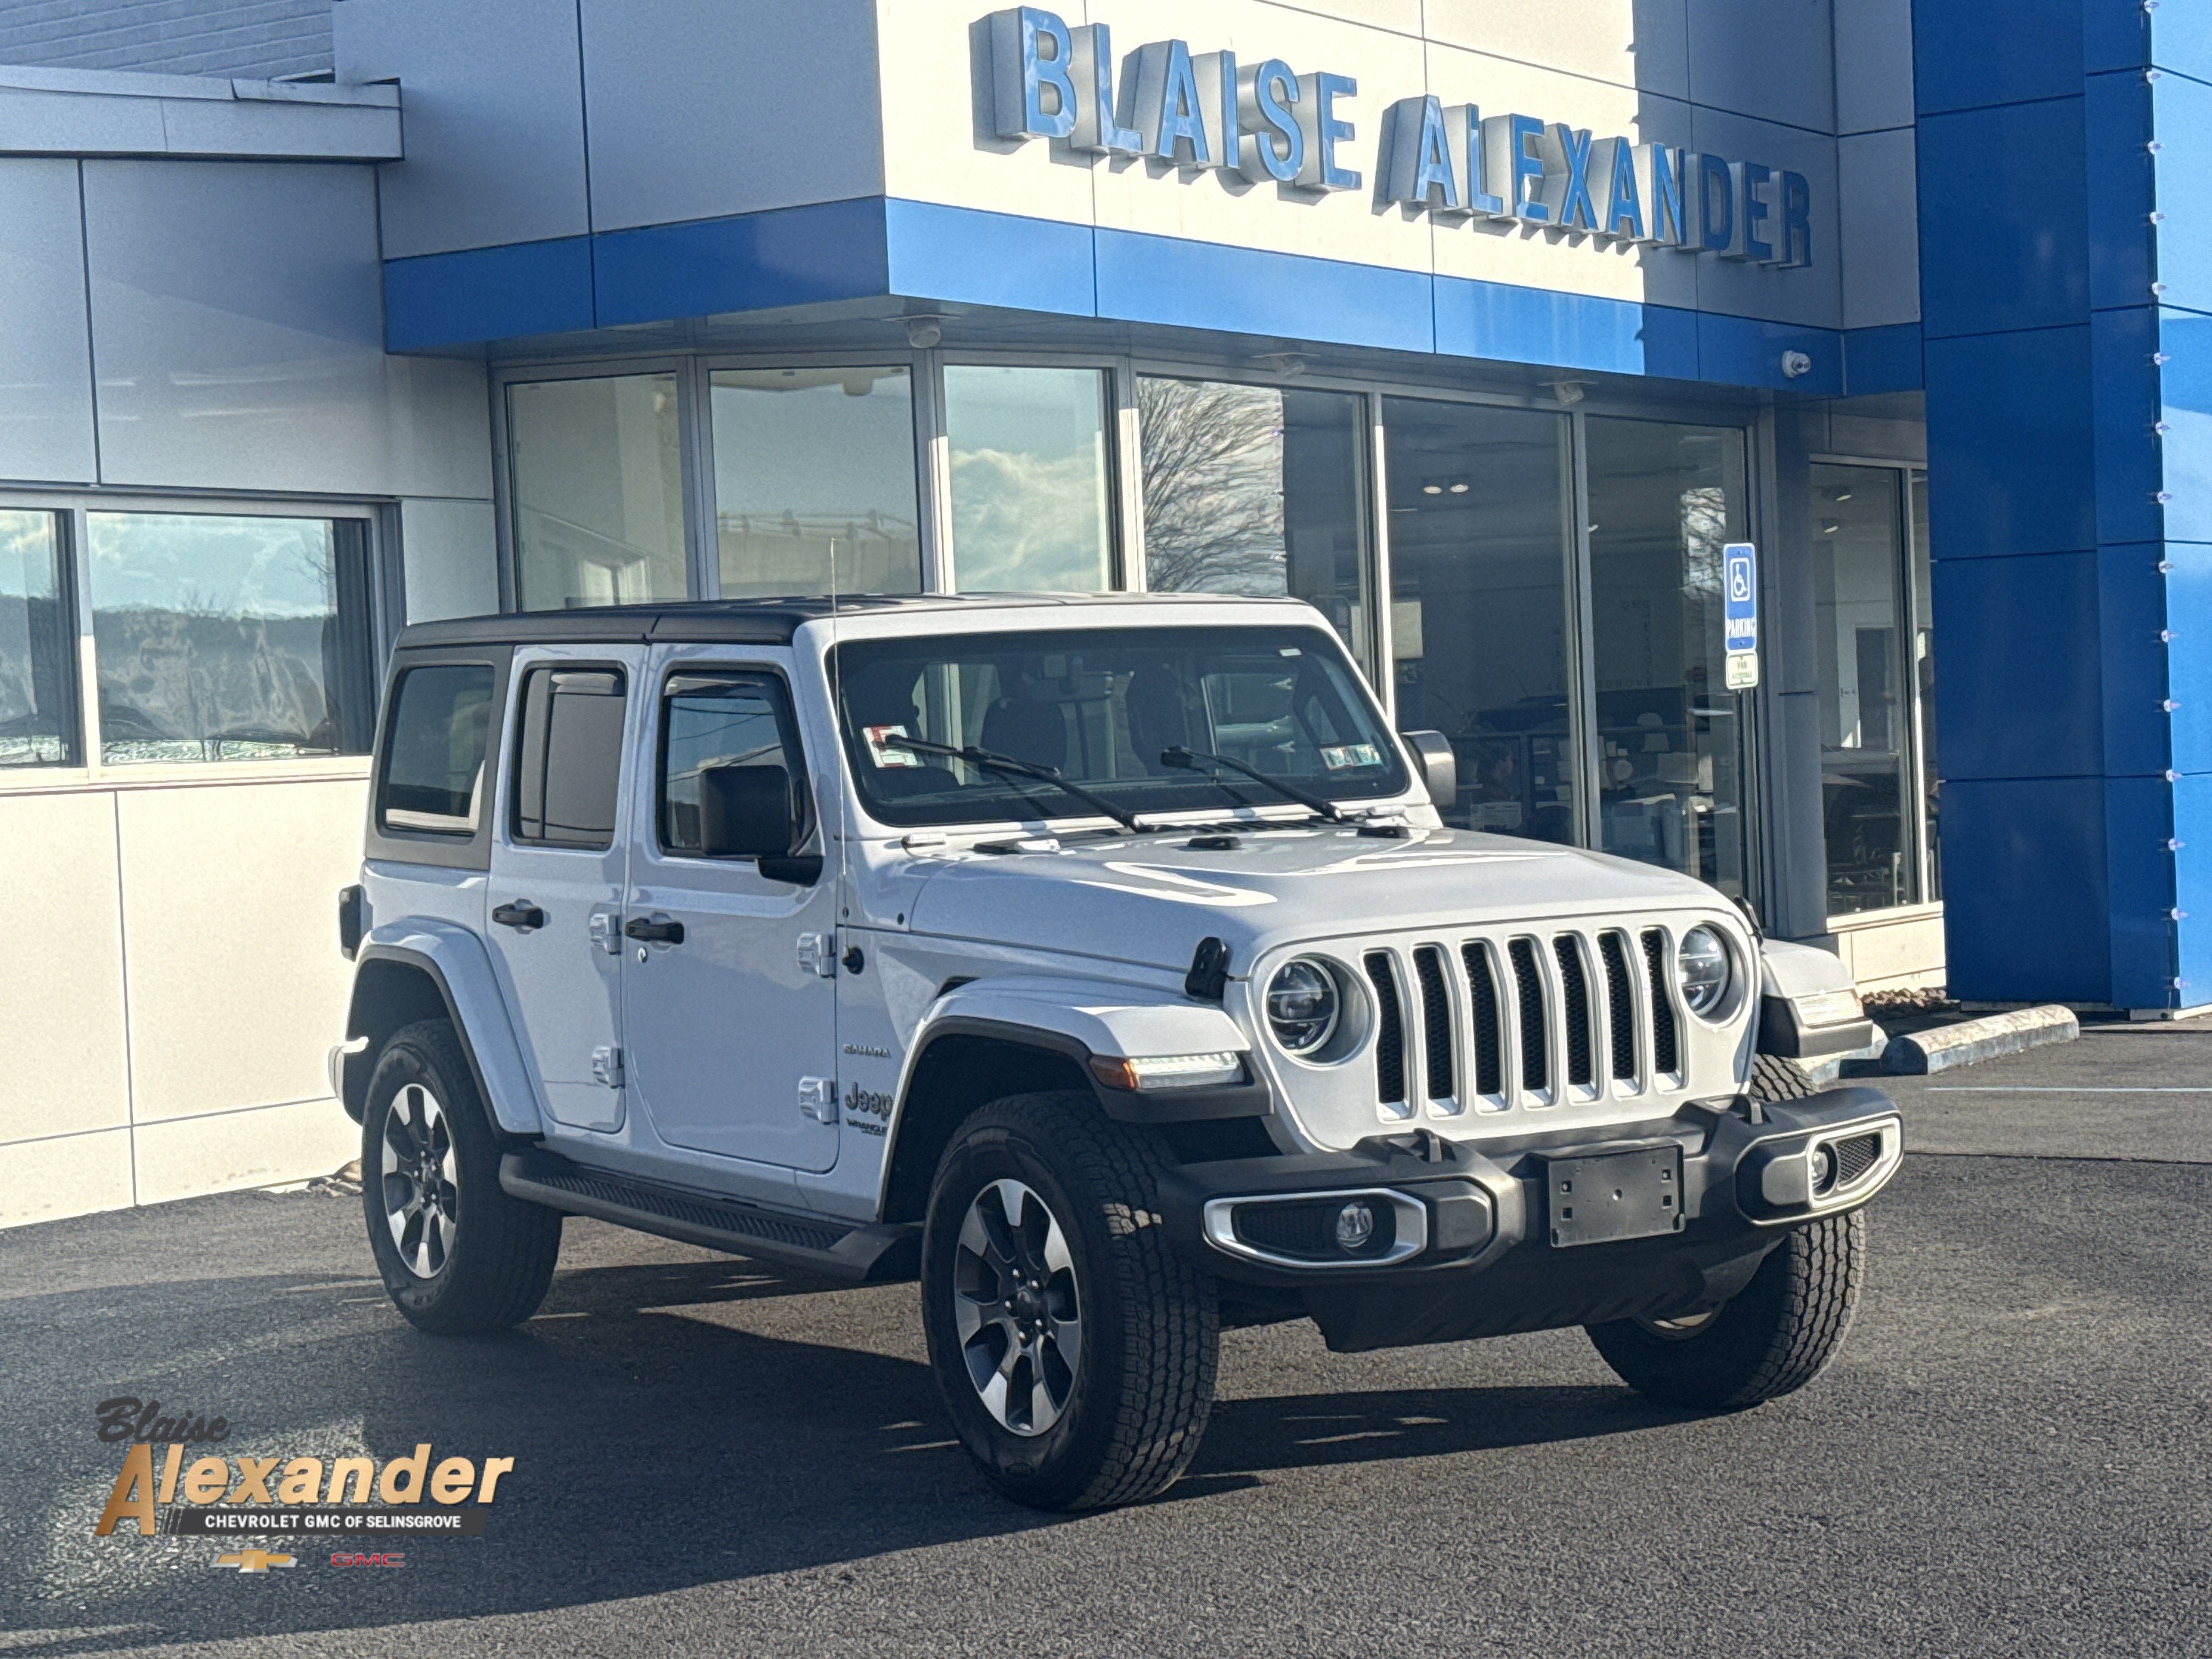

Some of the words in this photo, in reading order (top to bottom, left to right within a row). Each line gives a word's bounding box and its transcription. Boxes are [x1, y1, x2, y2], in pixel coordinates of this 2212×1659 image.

[1019, 7, 1361, 191] BLAISE
[1415, 94, 1813, 268] ALEXANDER
[1727, 618, 1754, 638] PARKING
[845, 1081, 893, 1122] Jeep
